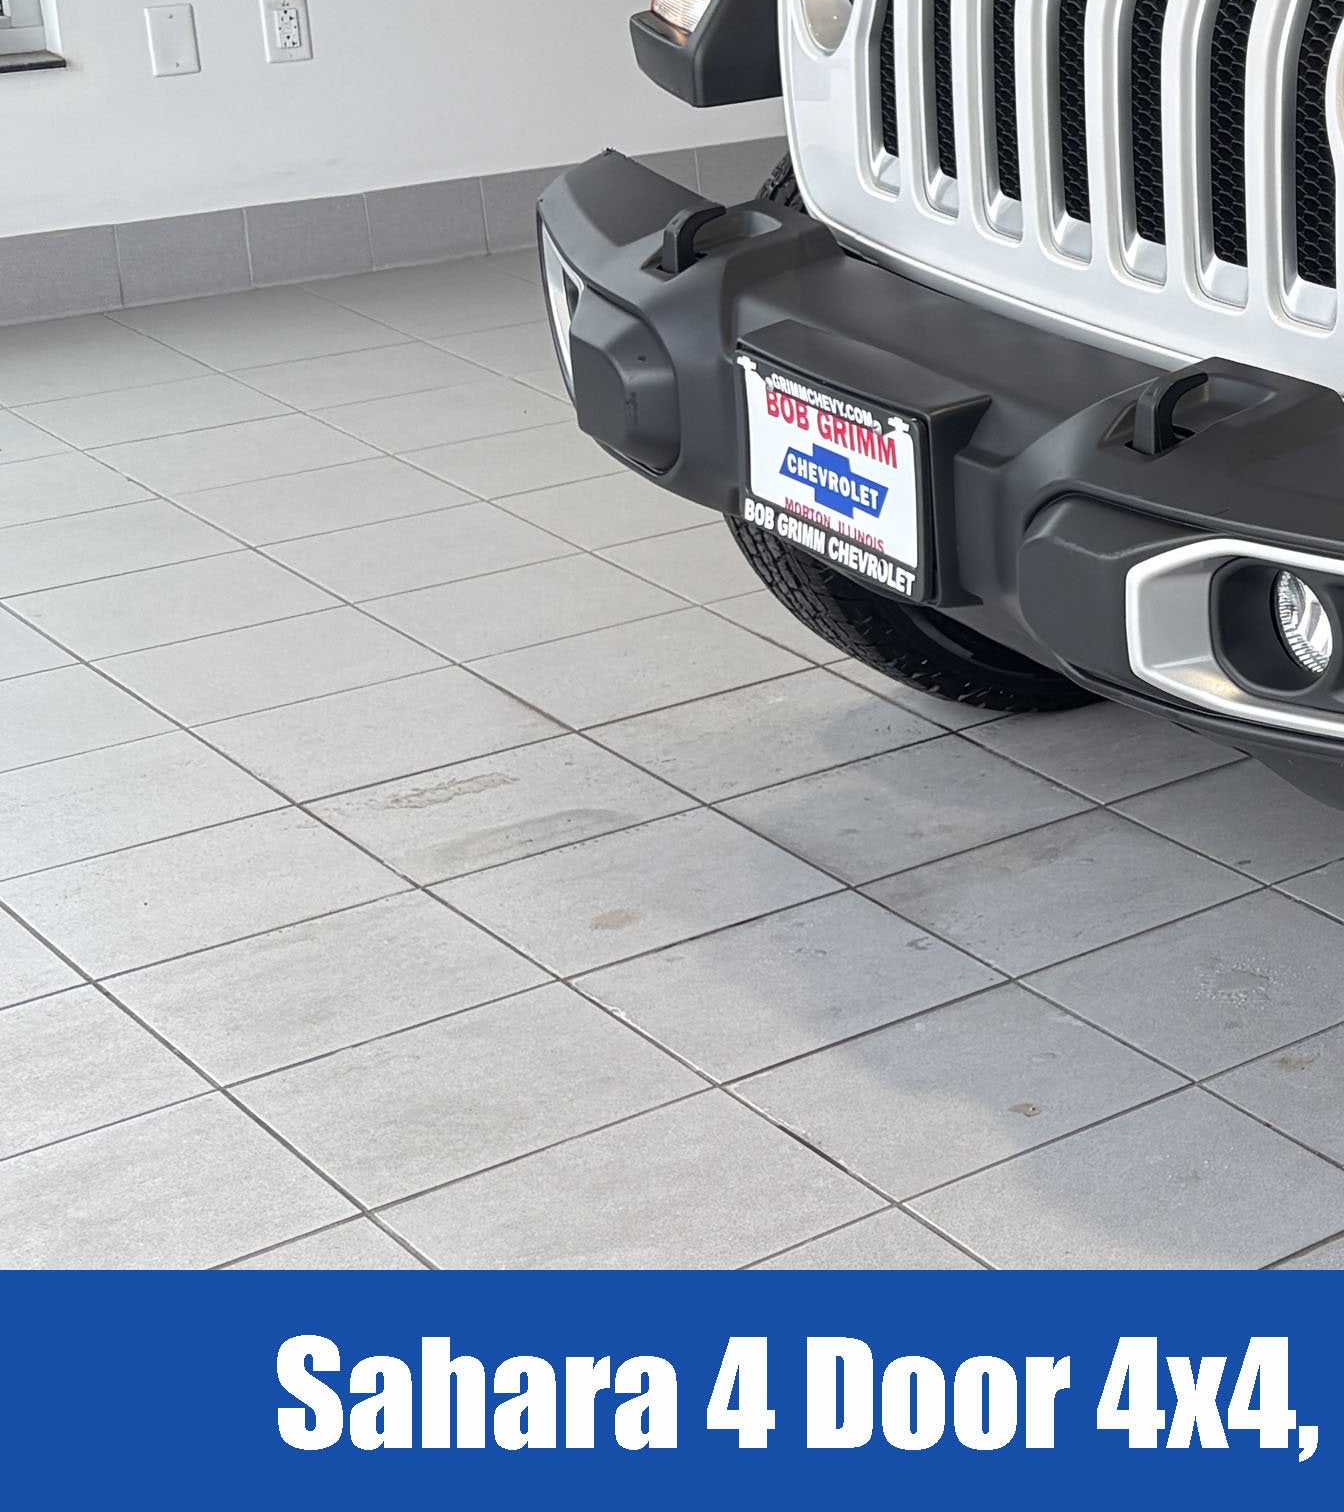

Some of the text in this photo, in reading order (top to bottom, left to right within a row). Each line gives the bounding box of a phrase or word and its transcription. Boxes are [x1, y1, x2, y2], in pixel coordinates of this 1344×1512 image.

[766, 389, 897, 469] BOB GRIMM
[771, 373, 873, 428] GRIMMCHEVY.COM
[786, 452, 880, 510] CHEVROLET
[744, 497, 916, 597] BOB GRIMM CHEVROLET
[838, 520, 885, 553] ILLINOIS
